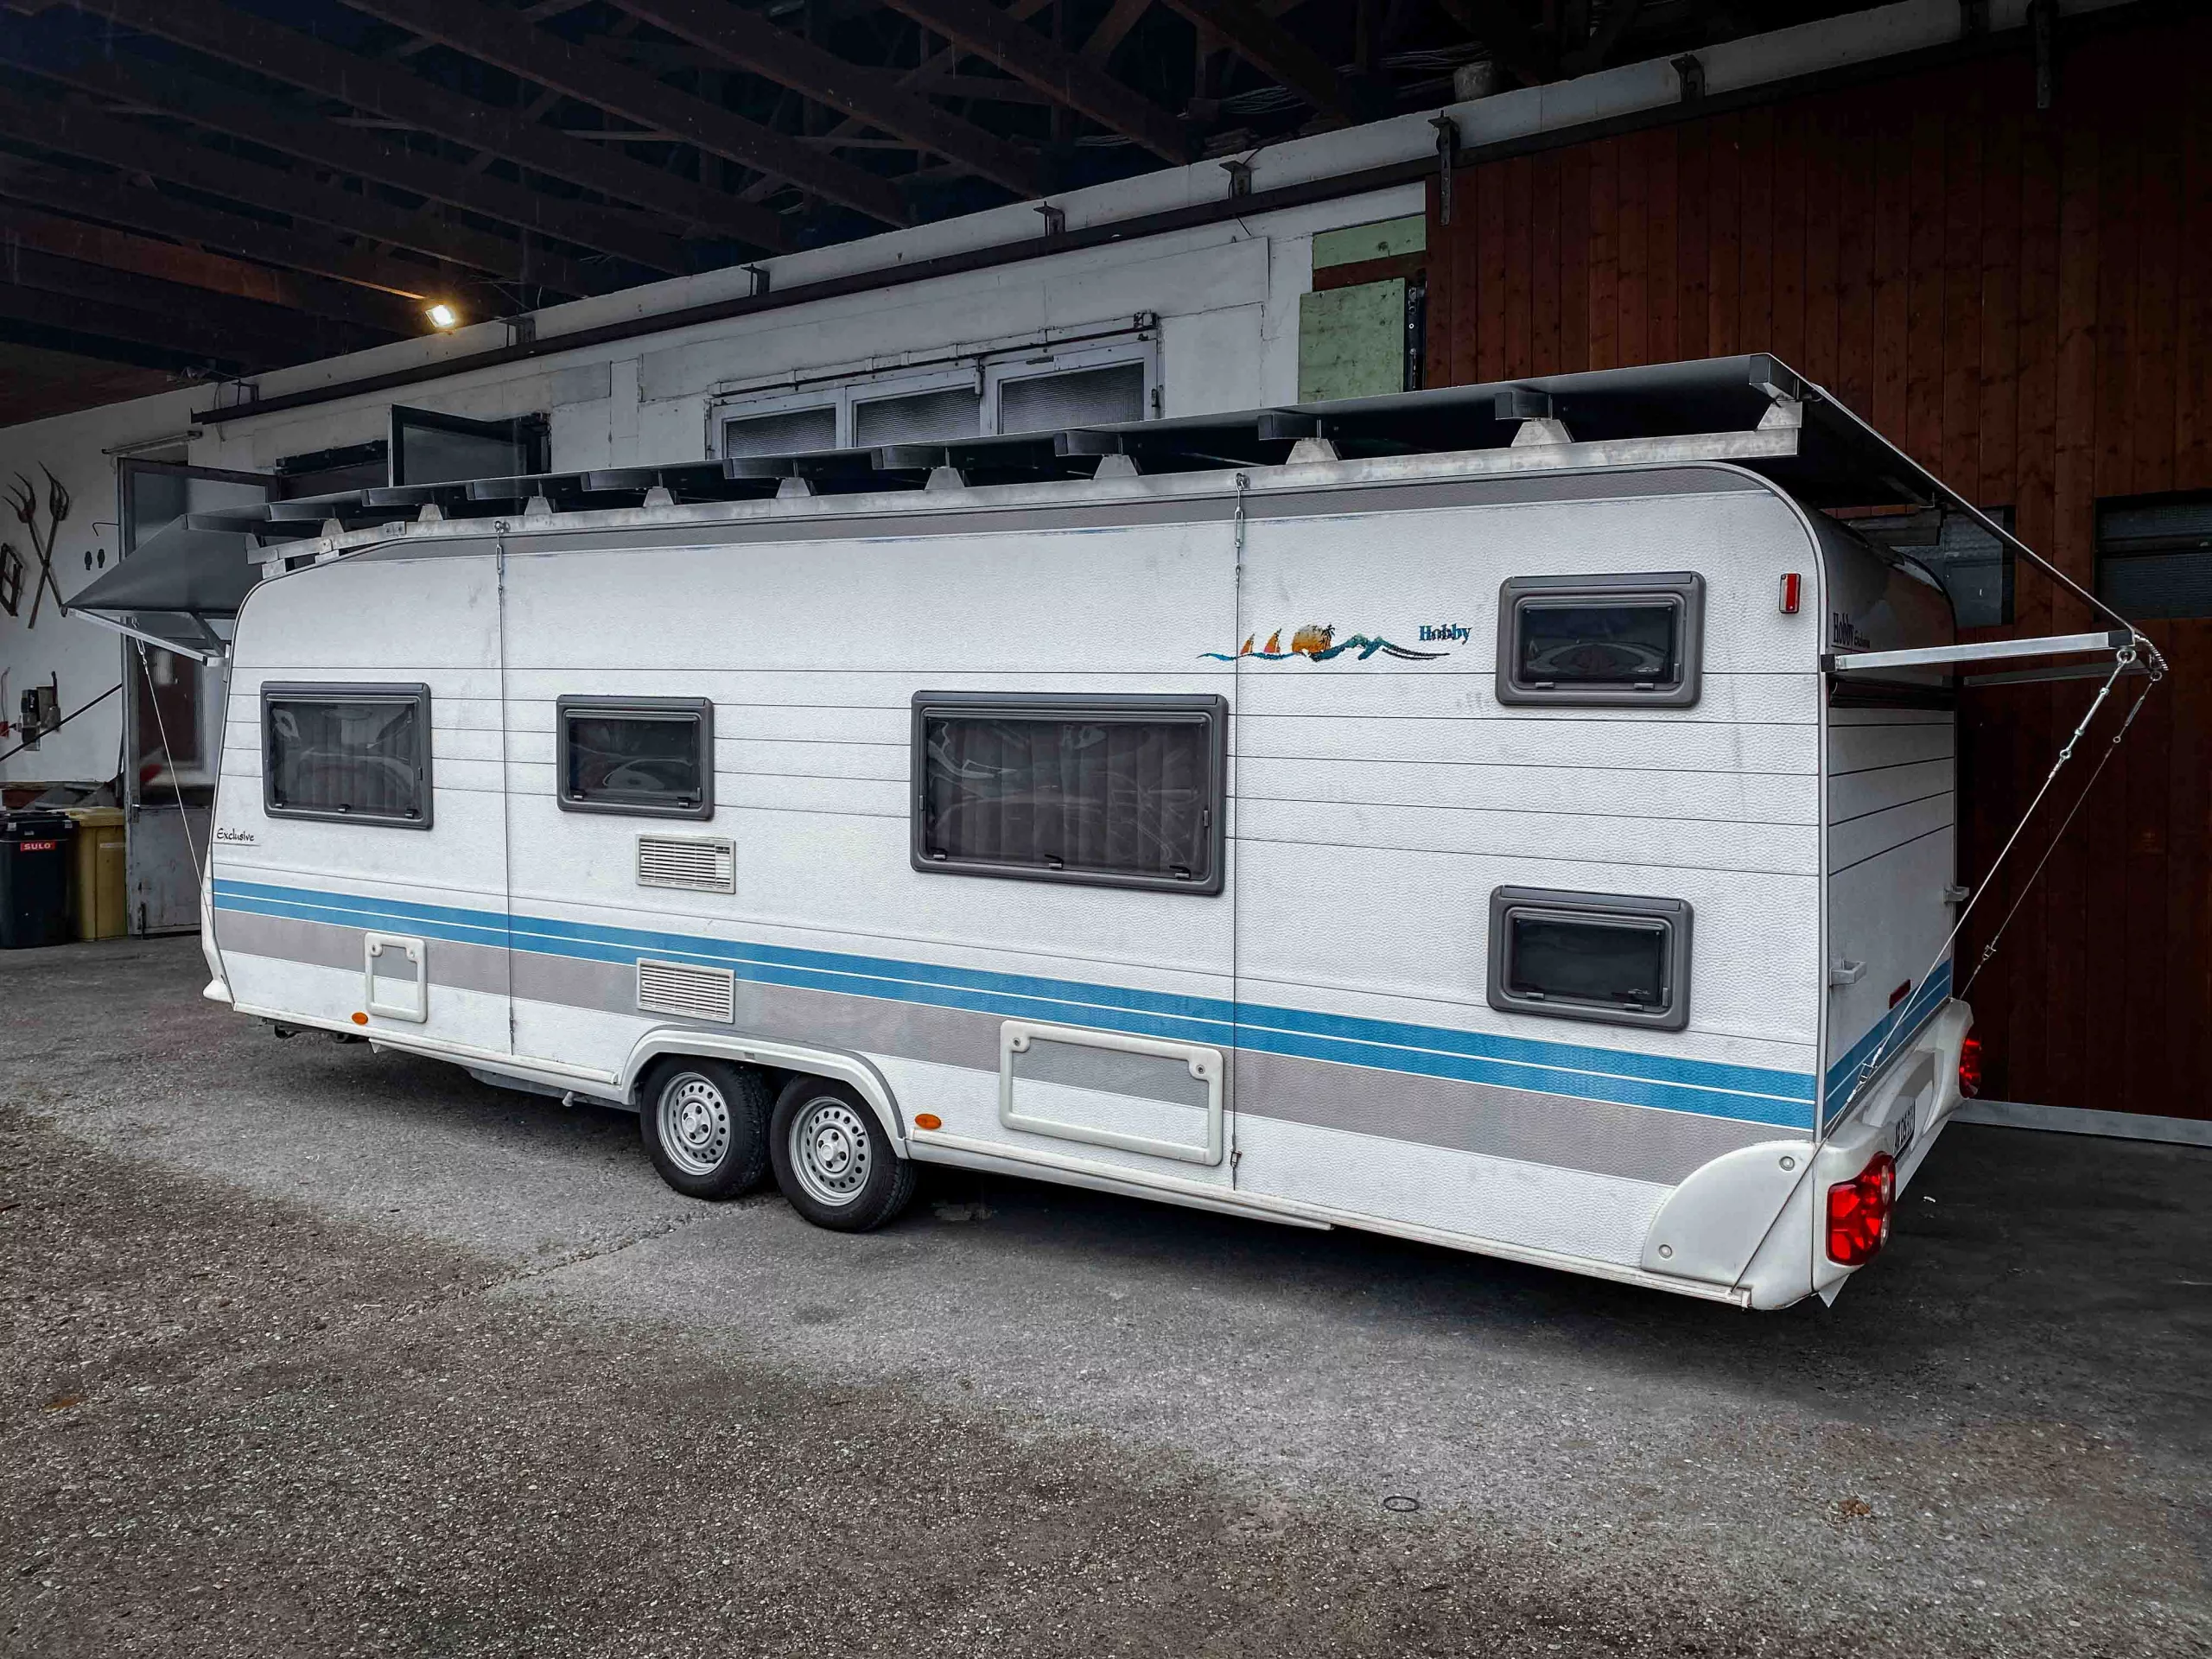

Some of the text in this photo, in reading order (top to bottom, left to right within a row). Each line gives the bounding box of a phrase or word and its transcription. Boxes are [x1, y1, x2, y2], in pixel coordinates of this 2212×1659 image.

[1419, 623, 1472, 645] Hobby
[1833, 613, 1855, 646] Hobby
[216, 827, 255, 842] Exclusive
